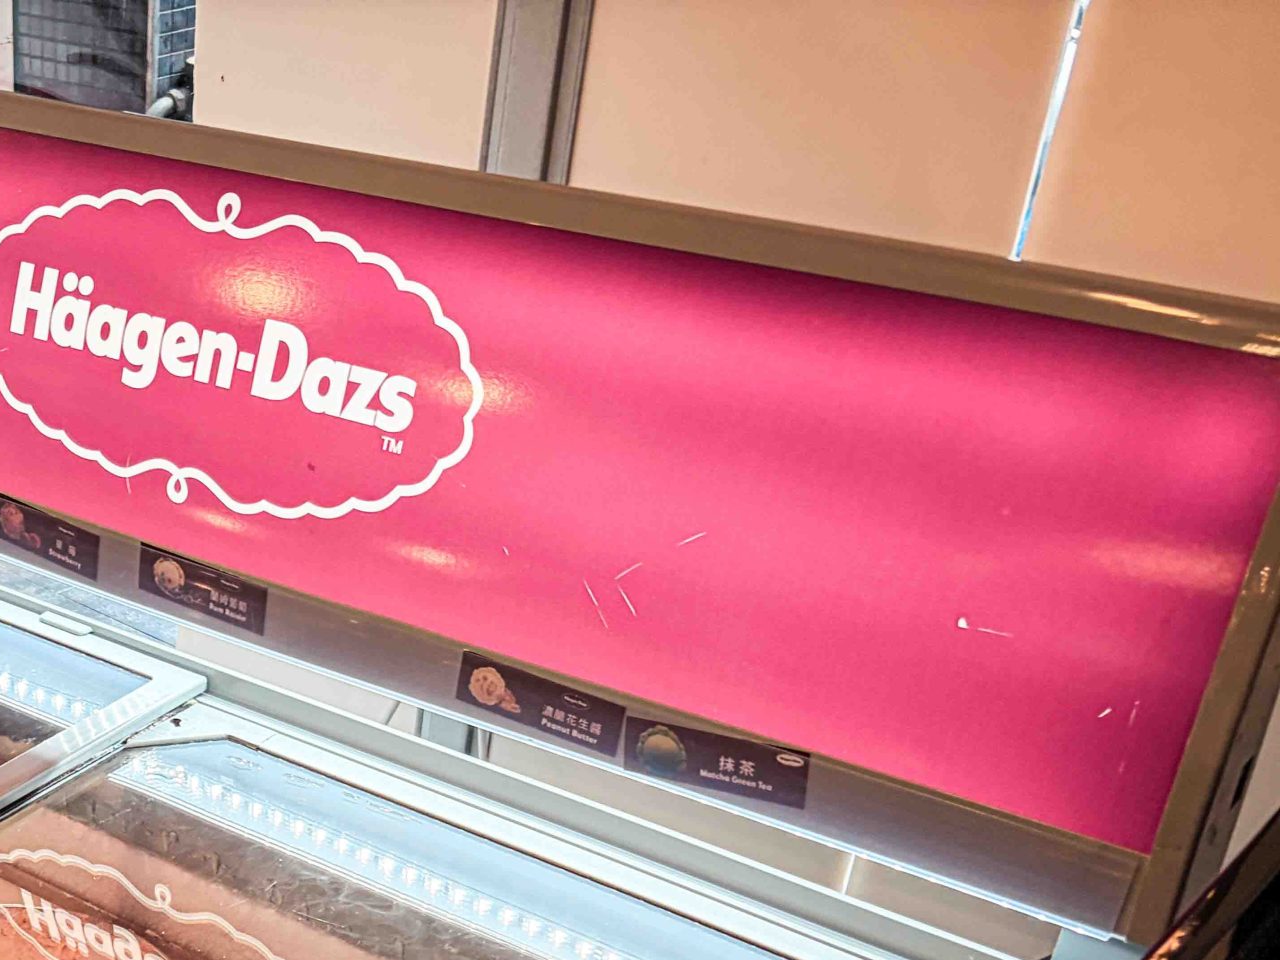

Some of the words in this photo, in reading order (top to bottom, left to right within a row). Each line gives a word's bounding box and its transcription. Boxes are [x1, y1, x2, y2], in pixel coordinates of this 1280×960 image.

[9, 260, 417, 433] Häagen-Dazs
[381, 435, 403, 455] TM
[719, 755, 756, 777] 抹茶
